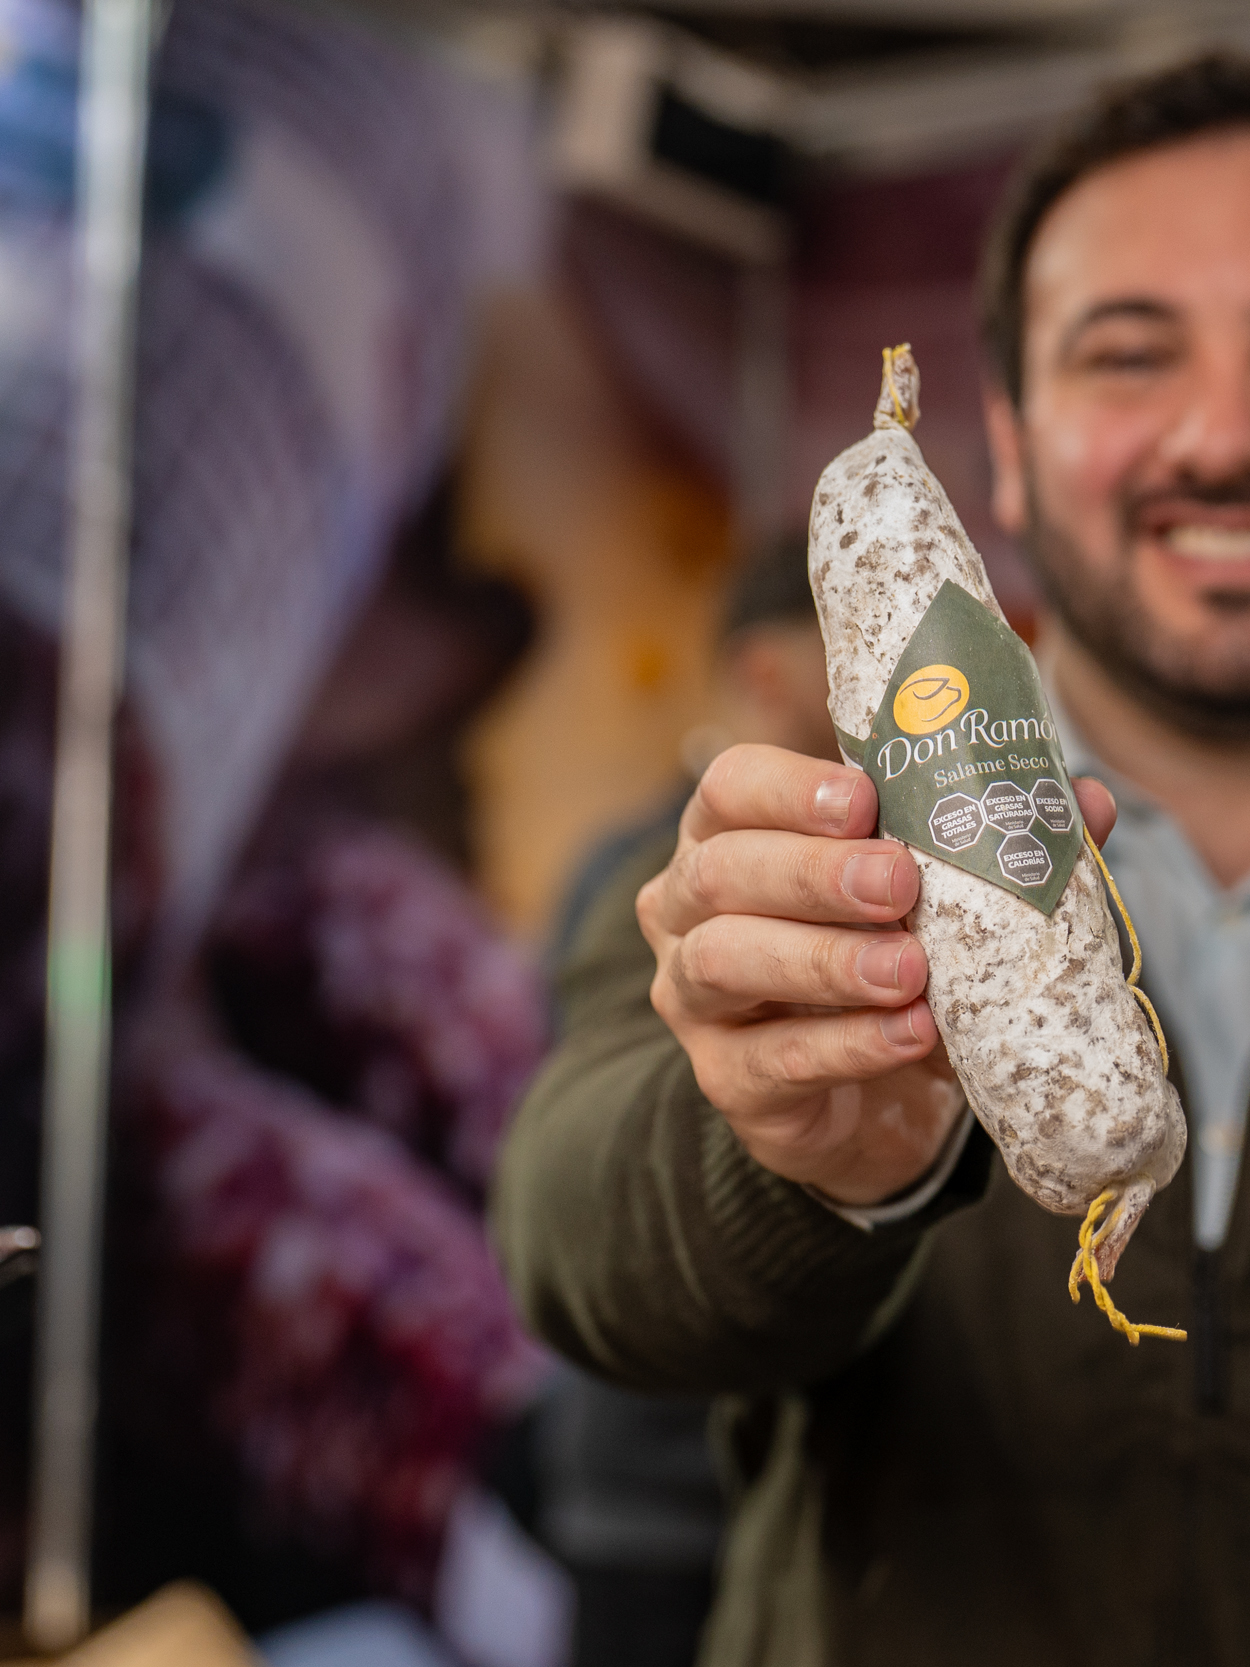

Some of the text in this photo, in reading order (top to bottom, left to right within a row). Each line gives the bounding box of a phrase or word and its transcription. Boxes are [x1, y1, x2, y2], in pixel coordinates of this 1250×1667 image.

[878, 729, 958, 782] Don
[934, 754, 1049, 788] Salame Seco
[986, 796, 1015, 805] EXCESO
[995, 803, 1023, 812] GRASAS
[934, 804, 976, 826] EXCESO EN
[941, 814, 972, 830] GRASAS
[989, 810, 1033, 821] SATURADAS
[942, 821, 976, 838] TOTALES
[1004, 852, 1033, 862] EXCESO
[1008, 857, 1045, 869] CALORÍAS
